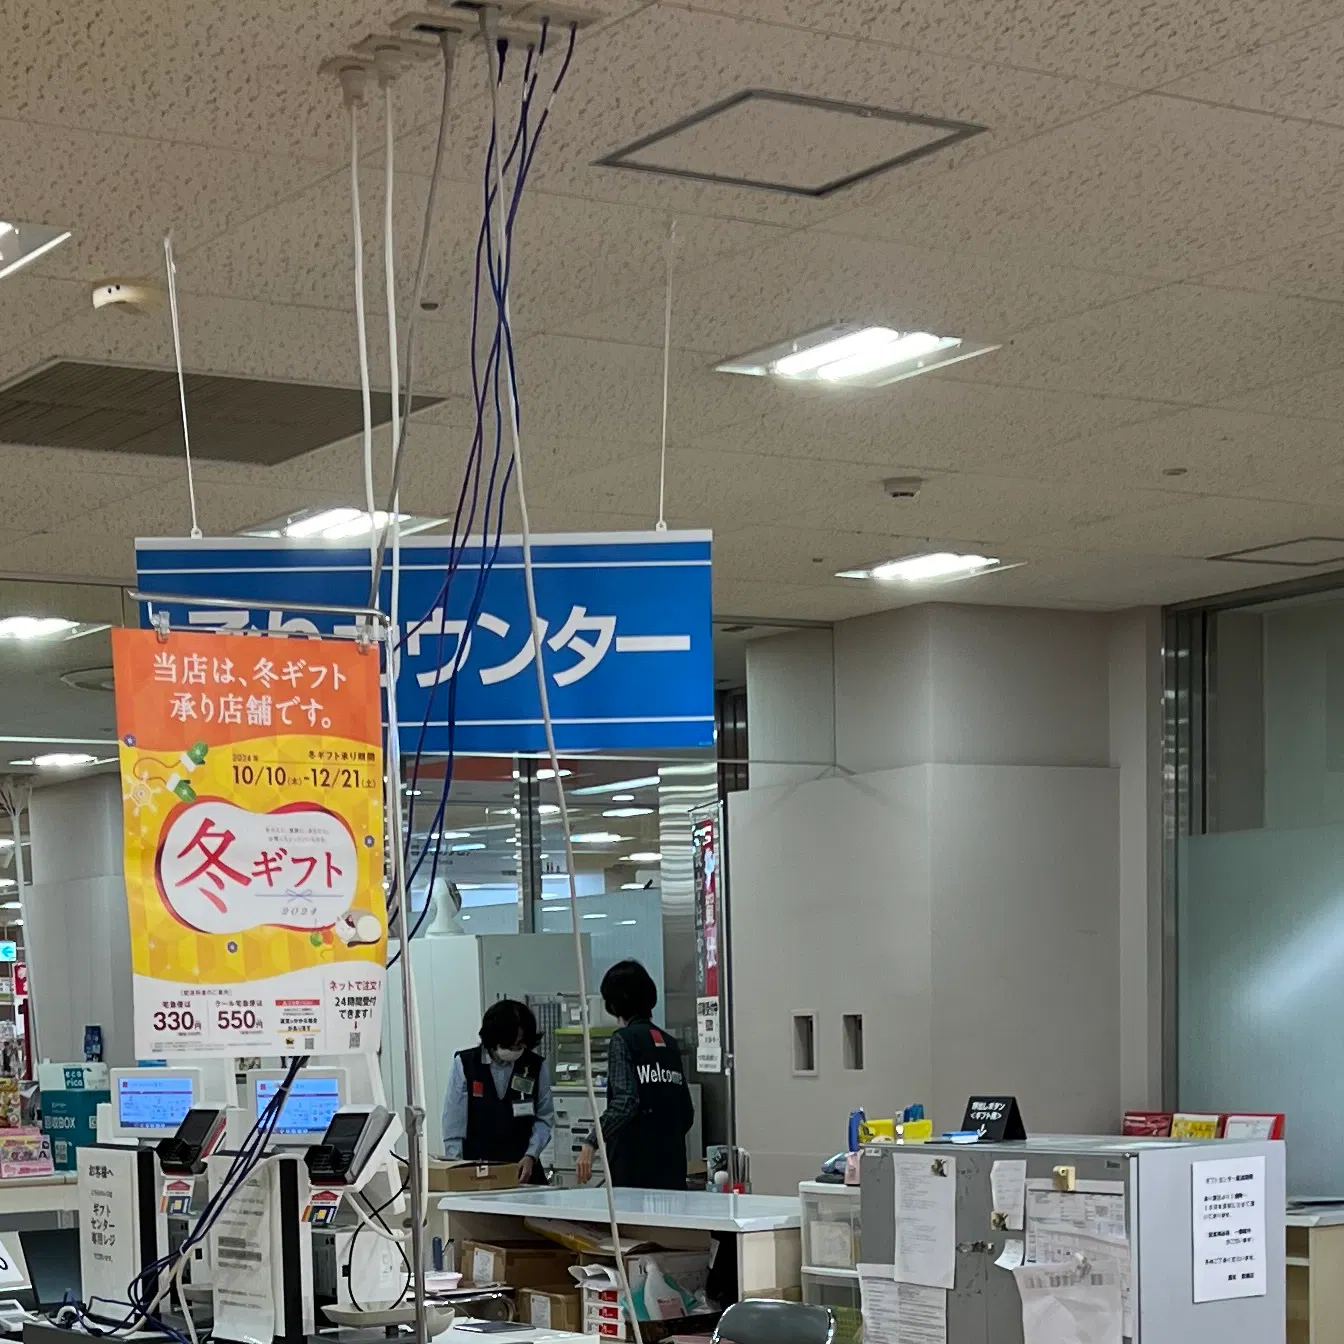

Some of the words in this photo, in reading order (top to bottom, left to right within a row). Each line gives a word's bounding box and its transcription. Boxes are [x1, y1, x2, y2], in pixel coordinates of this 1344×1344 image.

[153, 653, 347, 690] 当店は、冬ギフト
[170, 692, 332, 728] 承り店舗です。
[174, 817, 344, 914] 冬ギフト
[636, 1064, 683, 1086] Welcome
[91, 1217, 115, 1231] センター
[93, 1203, 111, 1218] ギフト
